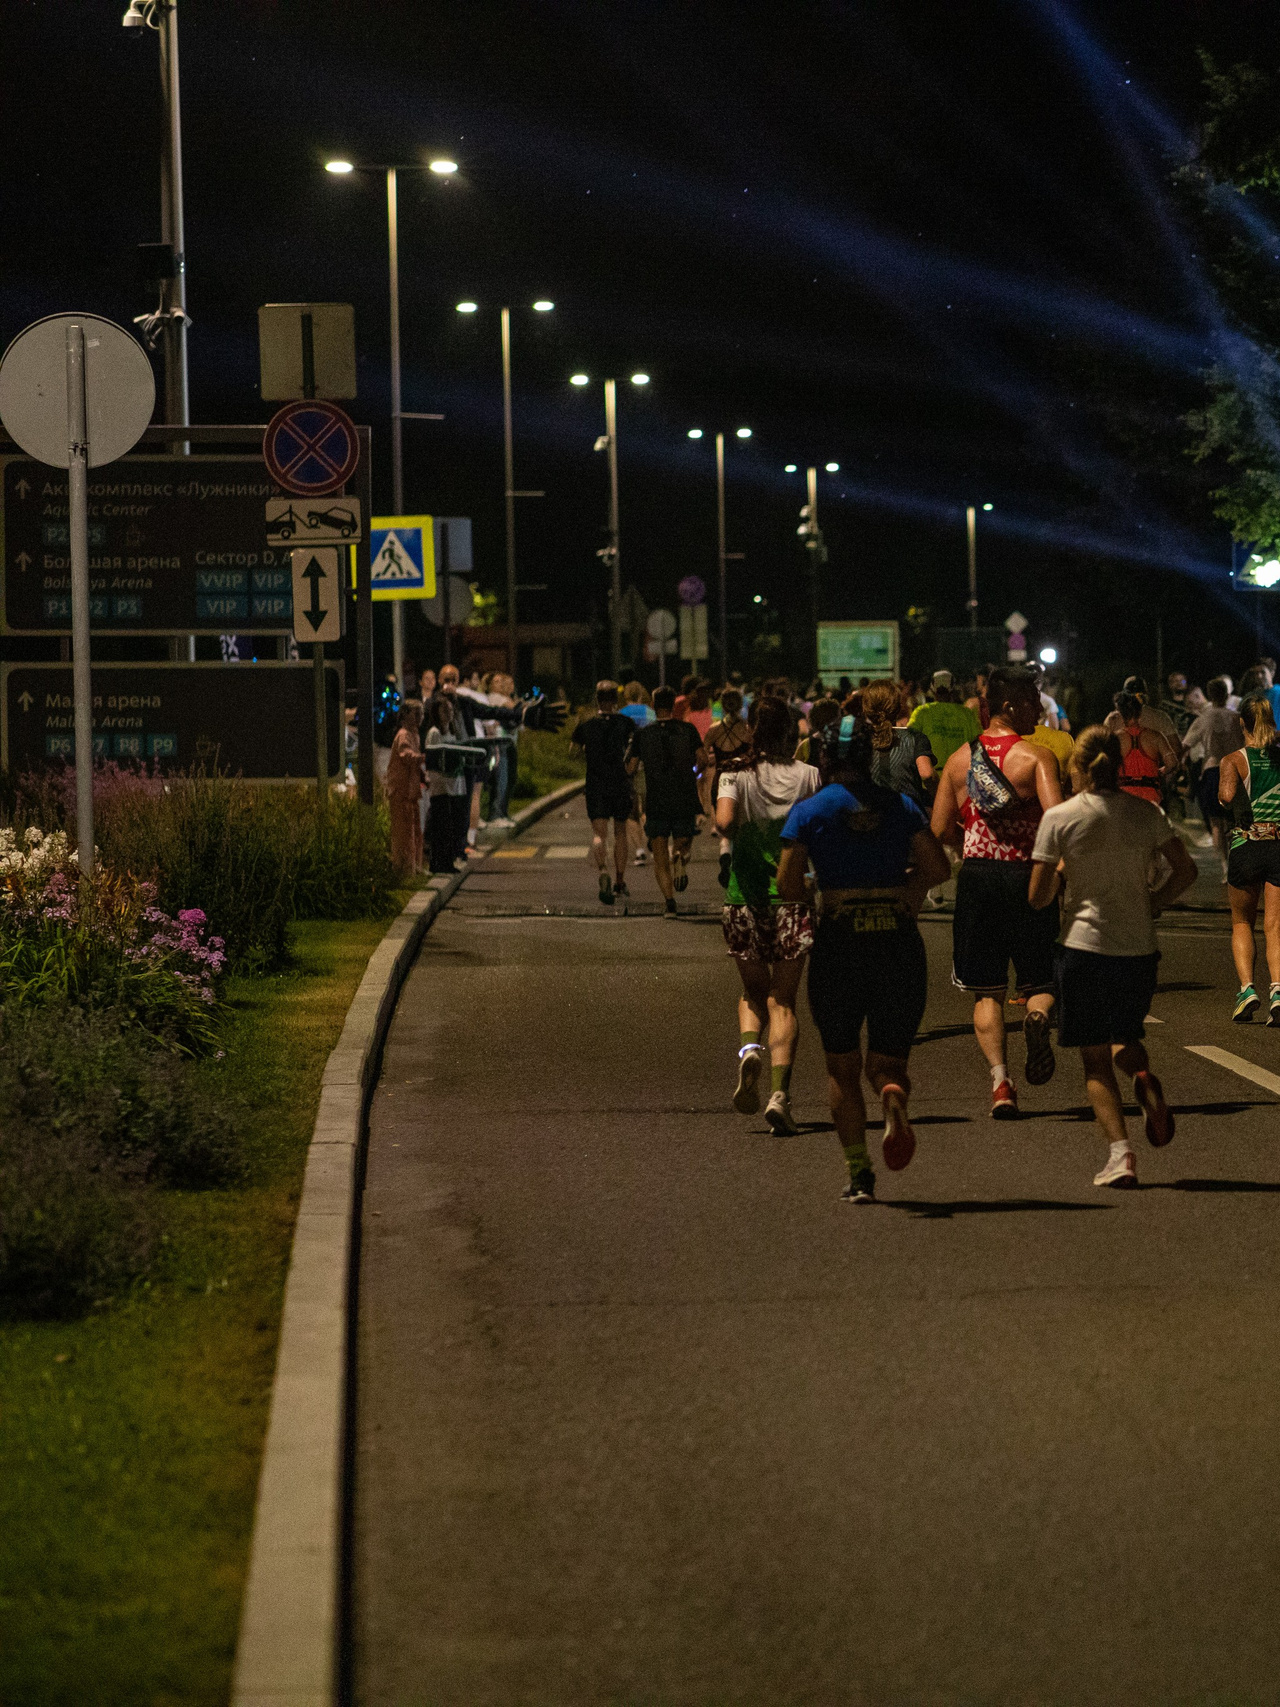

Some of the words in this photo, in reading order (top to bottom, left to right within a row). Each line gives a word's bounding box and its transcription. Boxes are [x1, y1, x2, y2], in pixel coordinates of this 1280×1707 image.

[42, 481, 172, 497] Аккомплекс
[42, 502, 99, 519] Aquic
[102, 503, 153, 517] Center
[126, 556, 181, 572] арена
[195, 551, 258, 568] Сектор
[263, 550, 277, 567] D,
[111, 576, 154, 589] Arena
[200, 573, 243, 588] VVIP
[254, 573, 285, 588] VIP
[48, 599, 68, 616] P1
[117, 599, 138, 615] P3
[206, 599, 237, 614] VIP
[255, 598, 285, 614] VIP
[45, 692, 103, 708] Мая
[107, 694, 161, 711] арена
[101, 715, 143, 728] Arena
[50, 738, 71, 753] P6
[152, 738, 174, 752] P9
